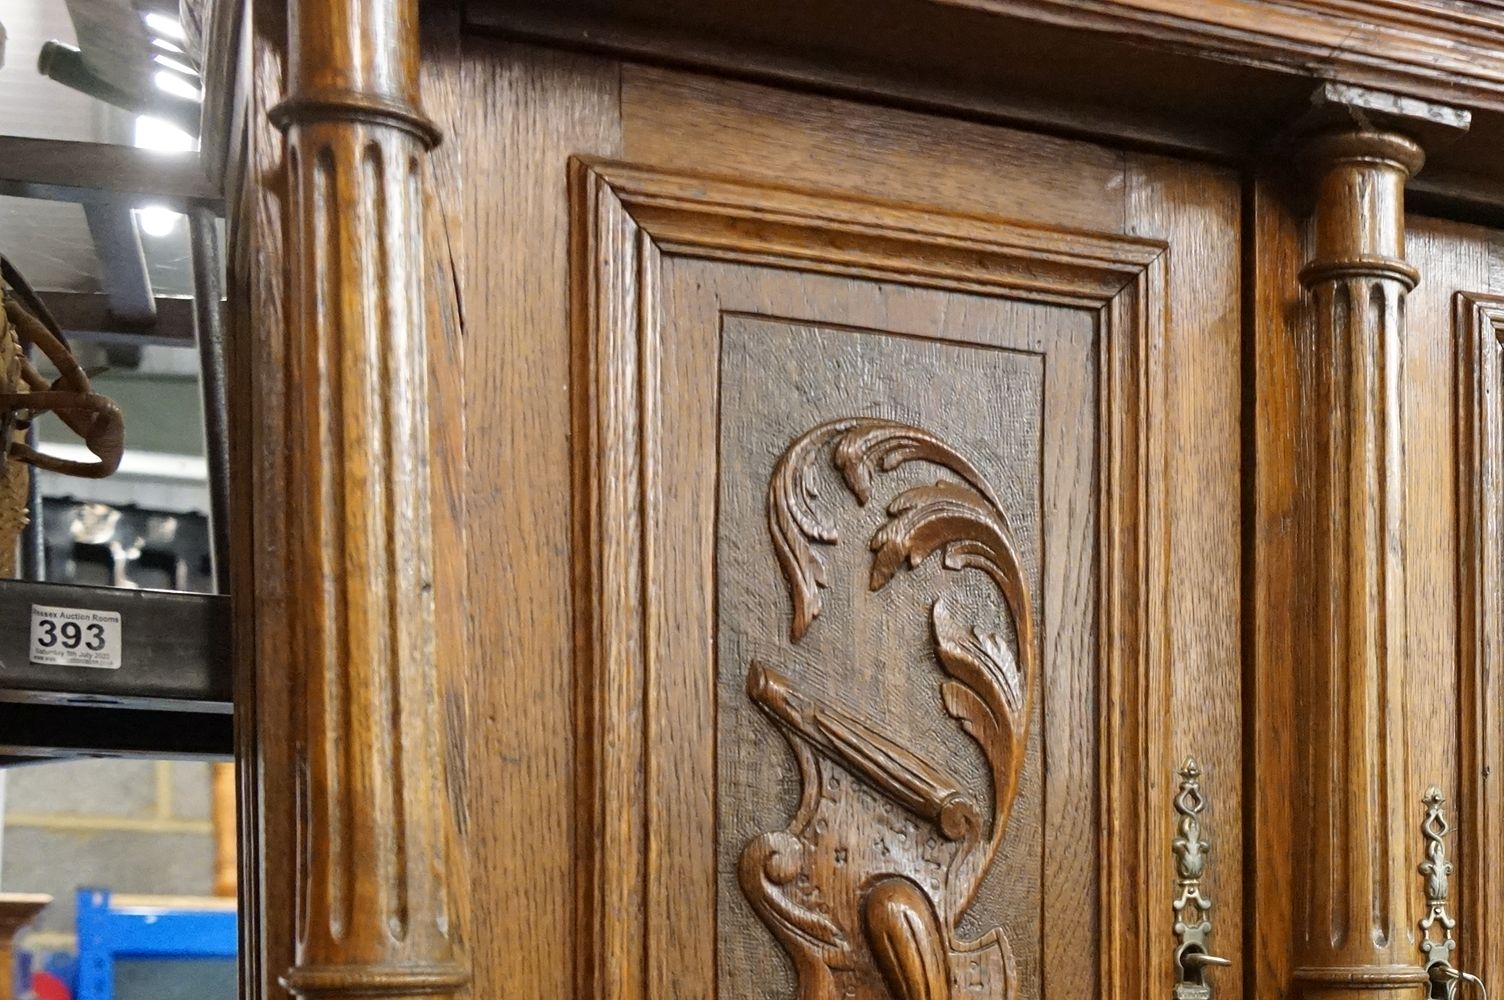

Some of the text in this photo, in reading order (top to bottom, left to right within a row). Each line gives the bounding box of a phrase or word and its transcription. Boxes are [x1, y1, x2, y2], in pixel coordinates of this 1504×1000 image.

[60, 611, 90, 620] Auction
[92, 614, 119, 623] Rooms
[38, 620, 106, 651] 393
